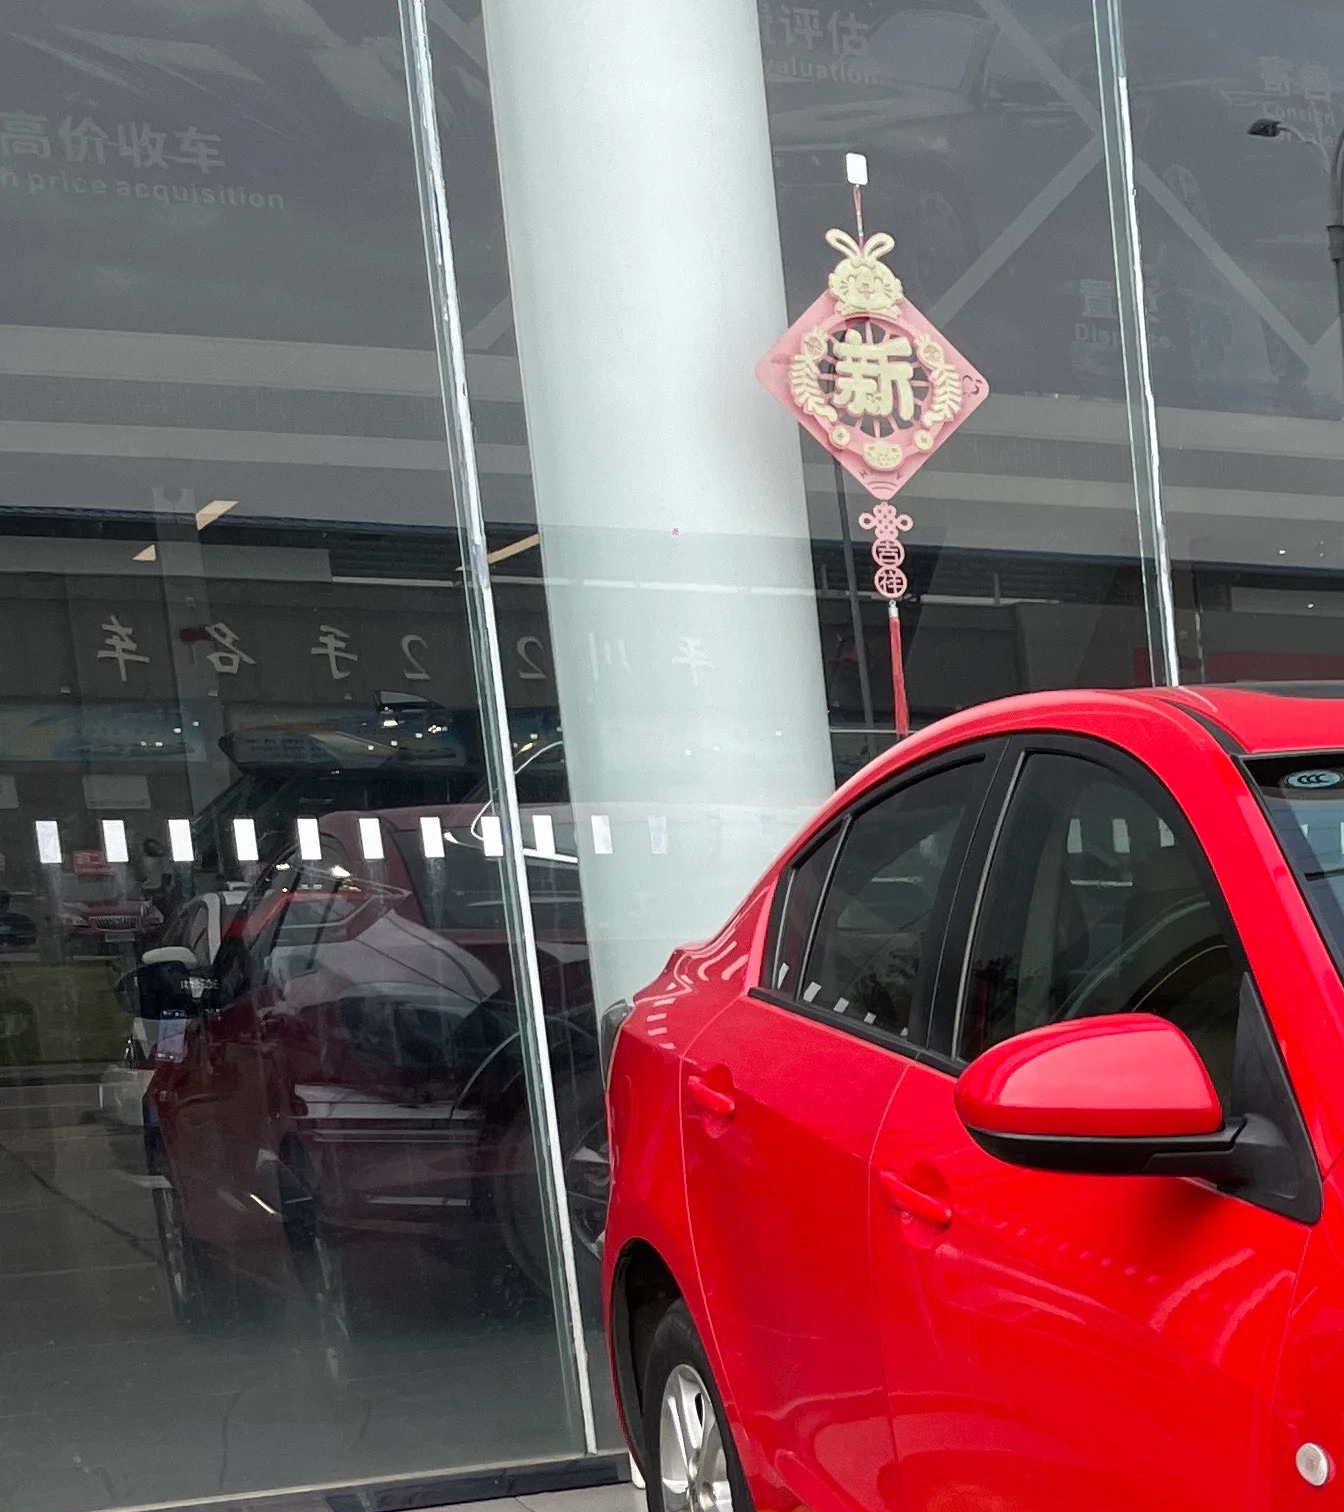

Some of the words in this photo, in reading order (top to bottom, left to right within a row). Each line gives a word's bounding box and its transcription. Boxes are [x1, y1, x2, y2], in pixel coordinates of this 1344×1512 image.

[0, 109, 226, 174] 高价收车
[29, 170, 107, 195] price
[116, 180, 285, 209] acquisition
[832, 329, 917, 422] 新
[873, 538, 906, 597] 吉祥
